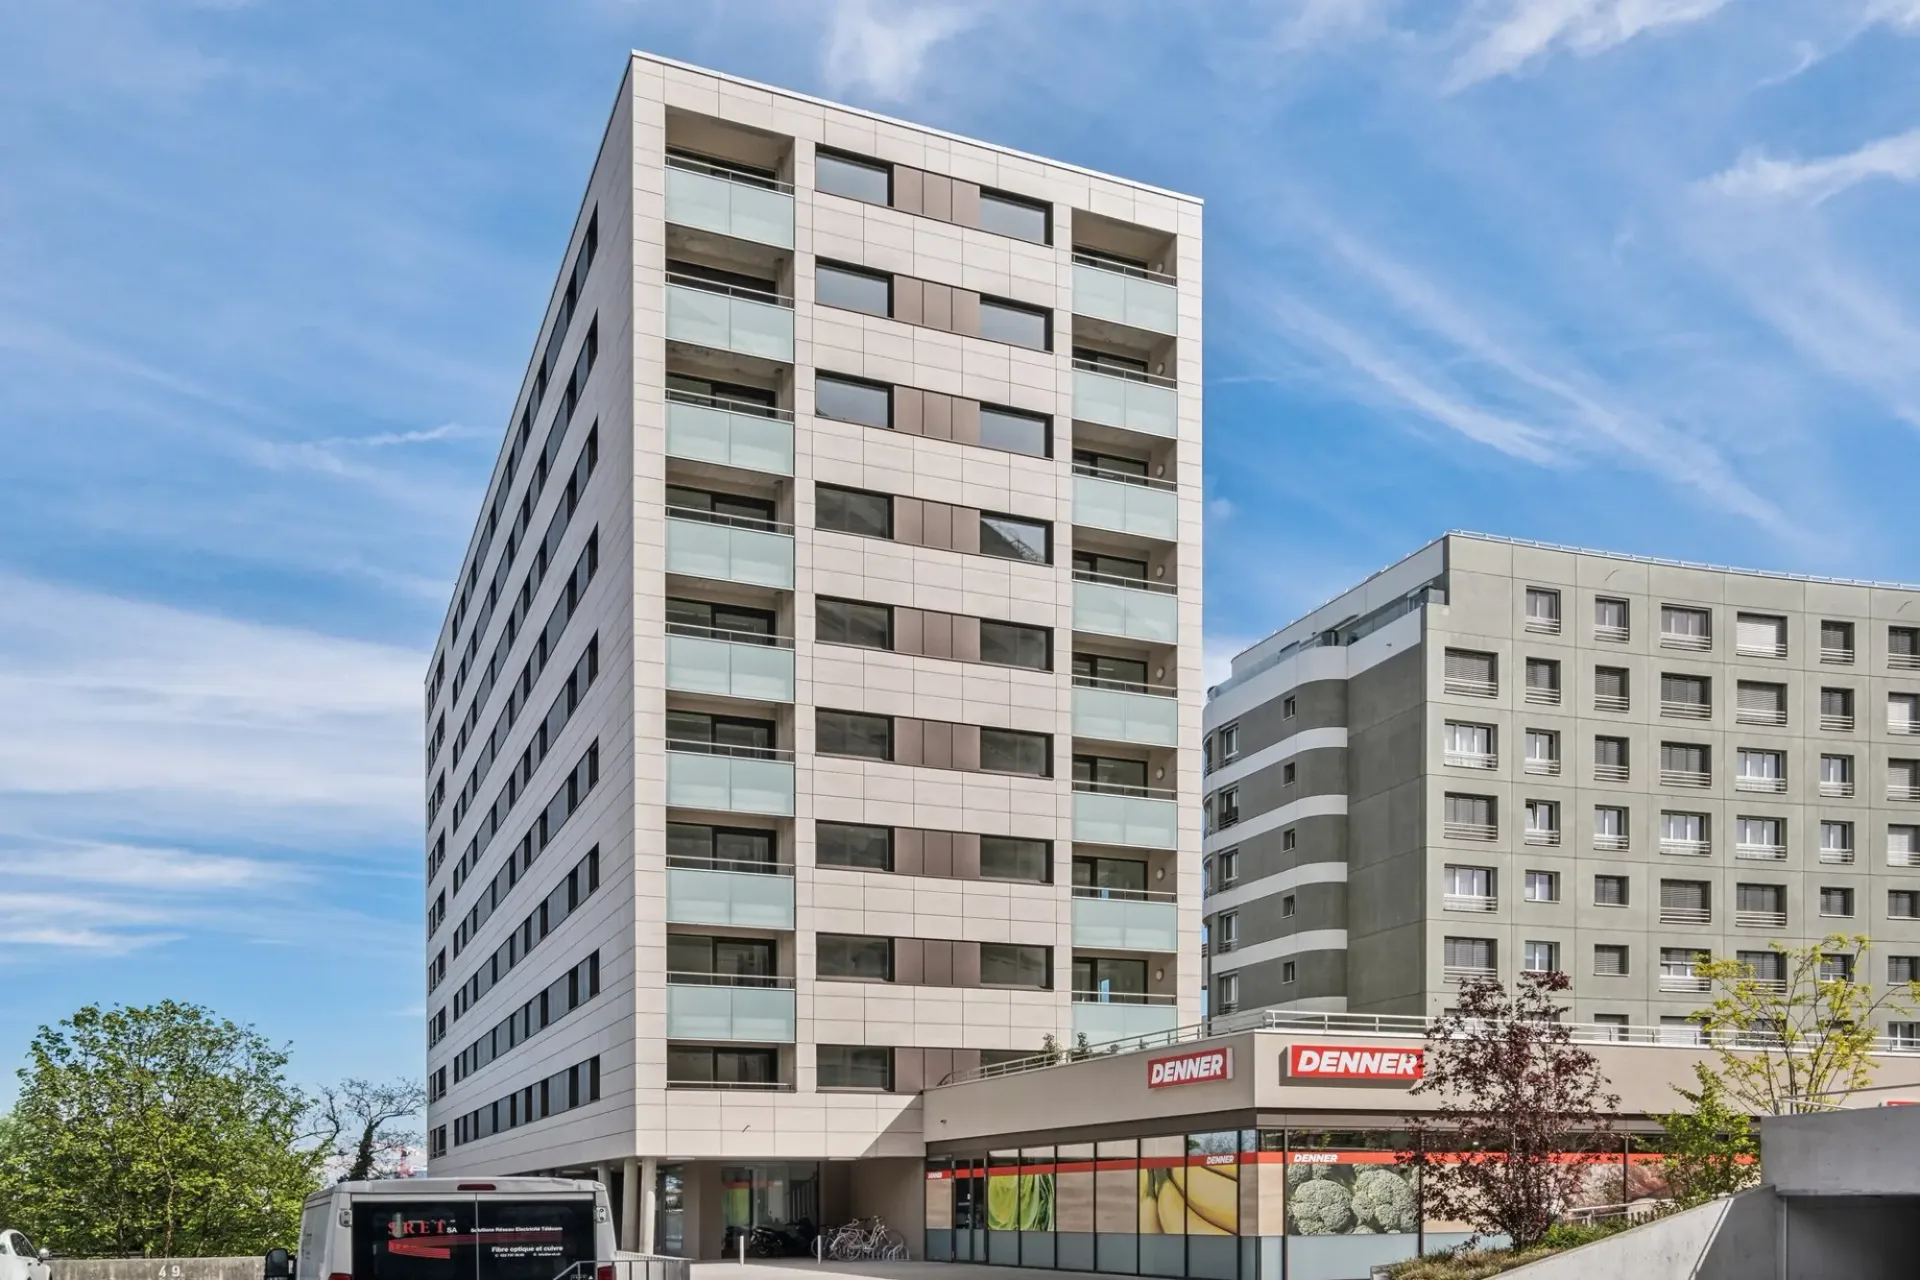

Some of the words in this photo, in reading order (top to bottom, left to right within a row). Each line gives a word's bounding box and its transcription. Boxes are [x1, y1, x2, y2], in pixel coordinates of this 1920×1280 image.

[1151, 1054, 1223, 1084] DENNER
[1297, 1050, 1417, 1075] DENNER
[1206, 1155, 1234, 1165] DENNER
[1293, 1153, 1338, 1163] DENNER
[388, 1219, 446, 1235] SRET
[446, 1226, 458, 1234] SA
[543, 1244, 564, 1252] cuivre
